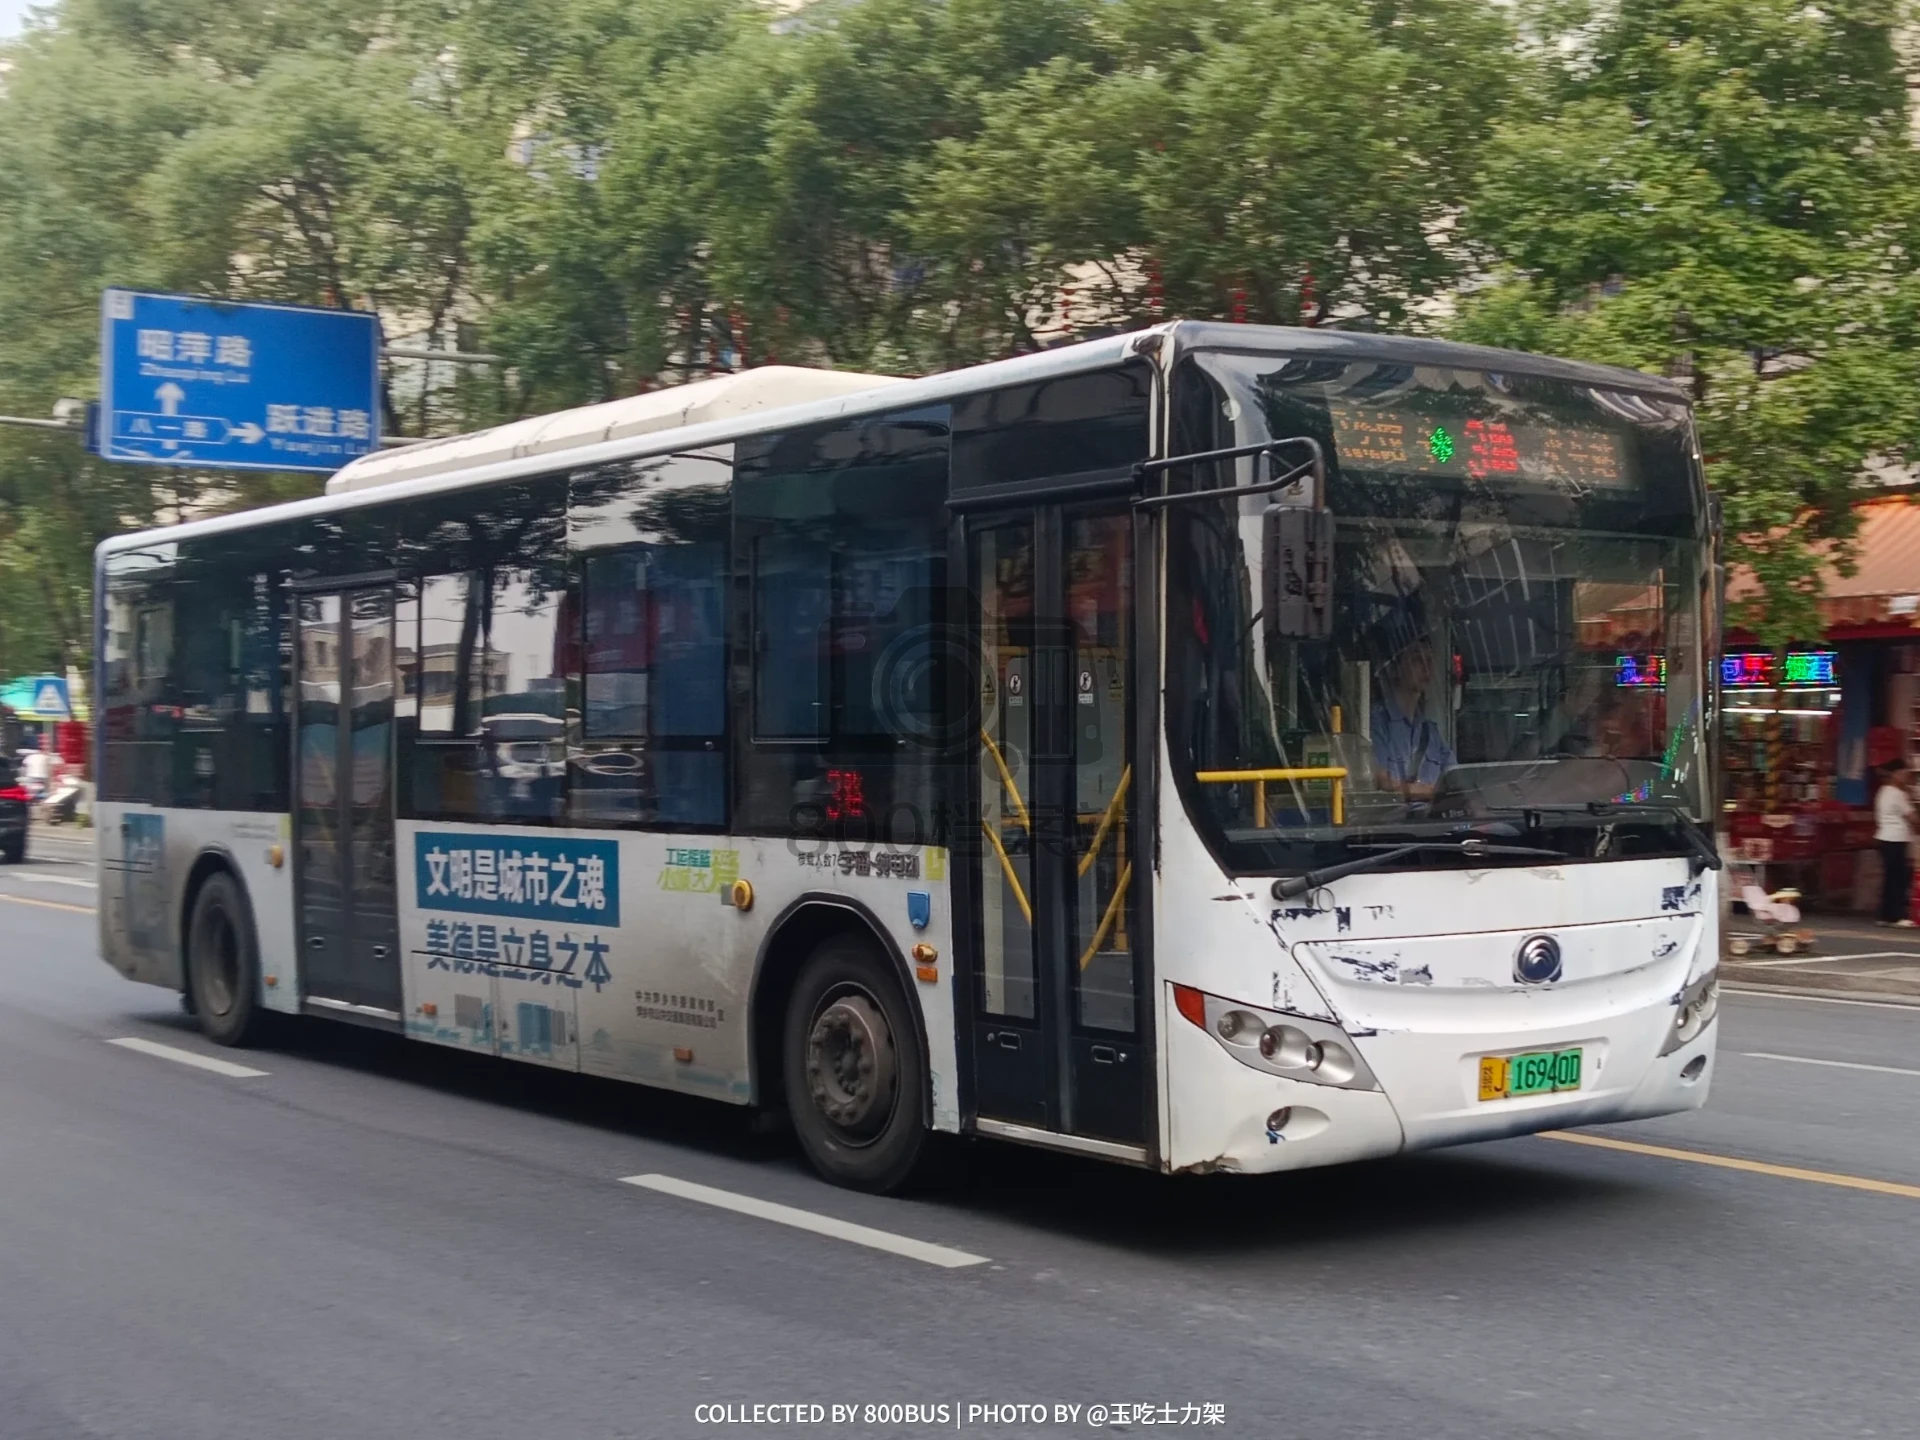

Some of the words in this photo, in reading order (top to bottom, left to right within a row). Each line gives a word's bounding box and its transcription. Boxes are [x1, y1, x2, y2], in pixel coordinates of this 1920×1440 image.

[425, 846, 607, 910] 文明是城市之魂
[426, 918, 612, 994] 美德是立身之本
